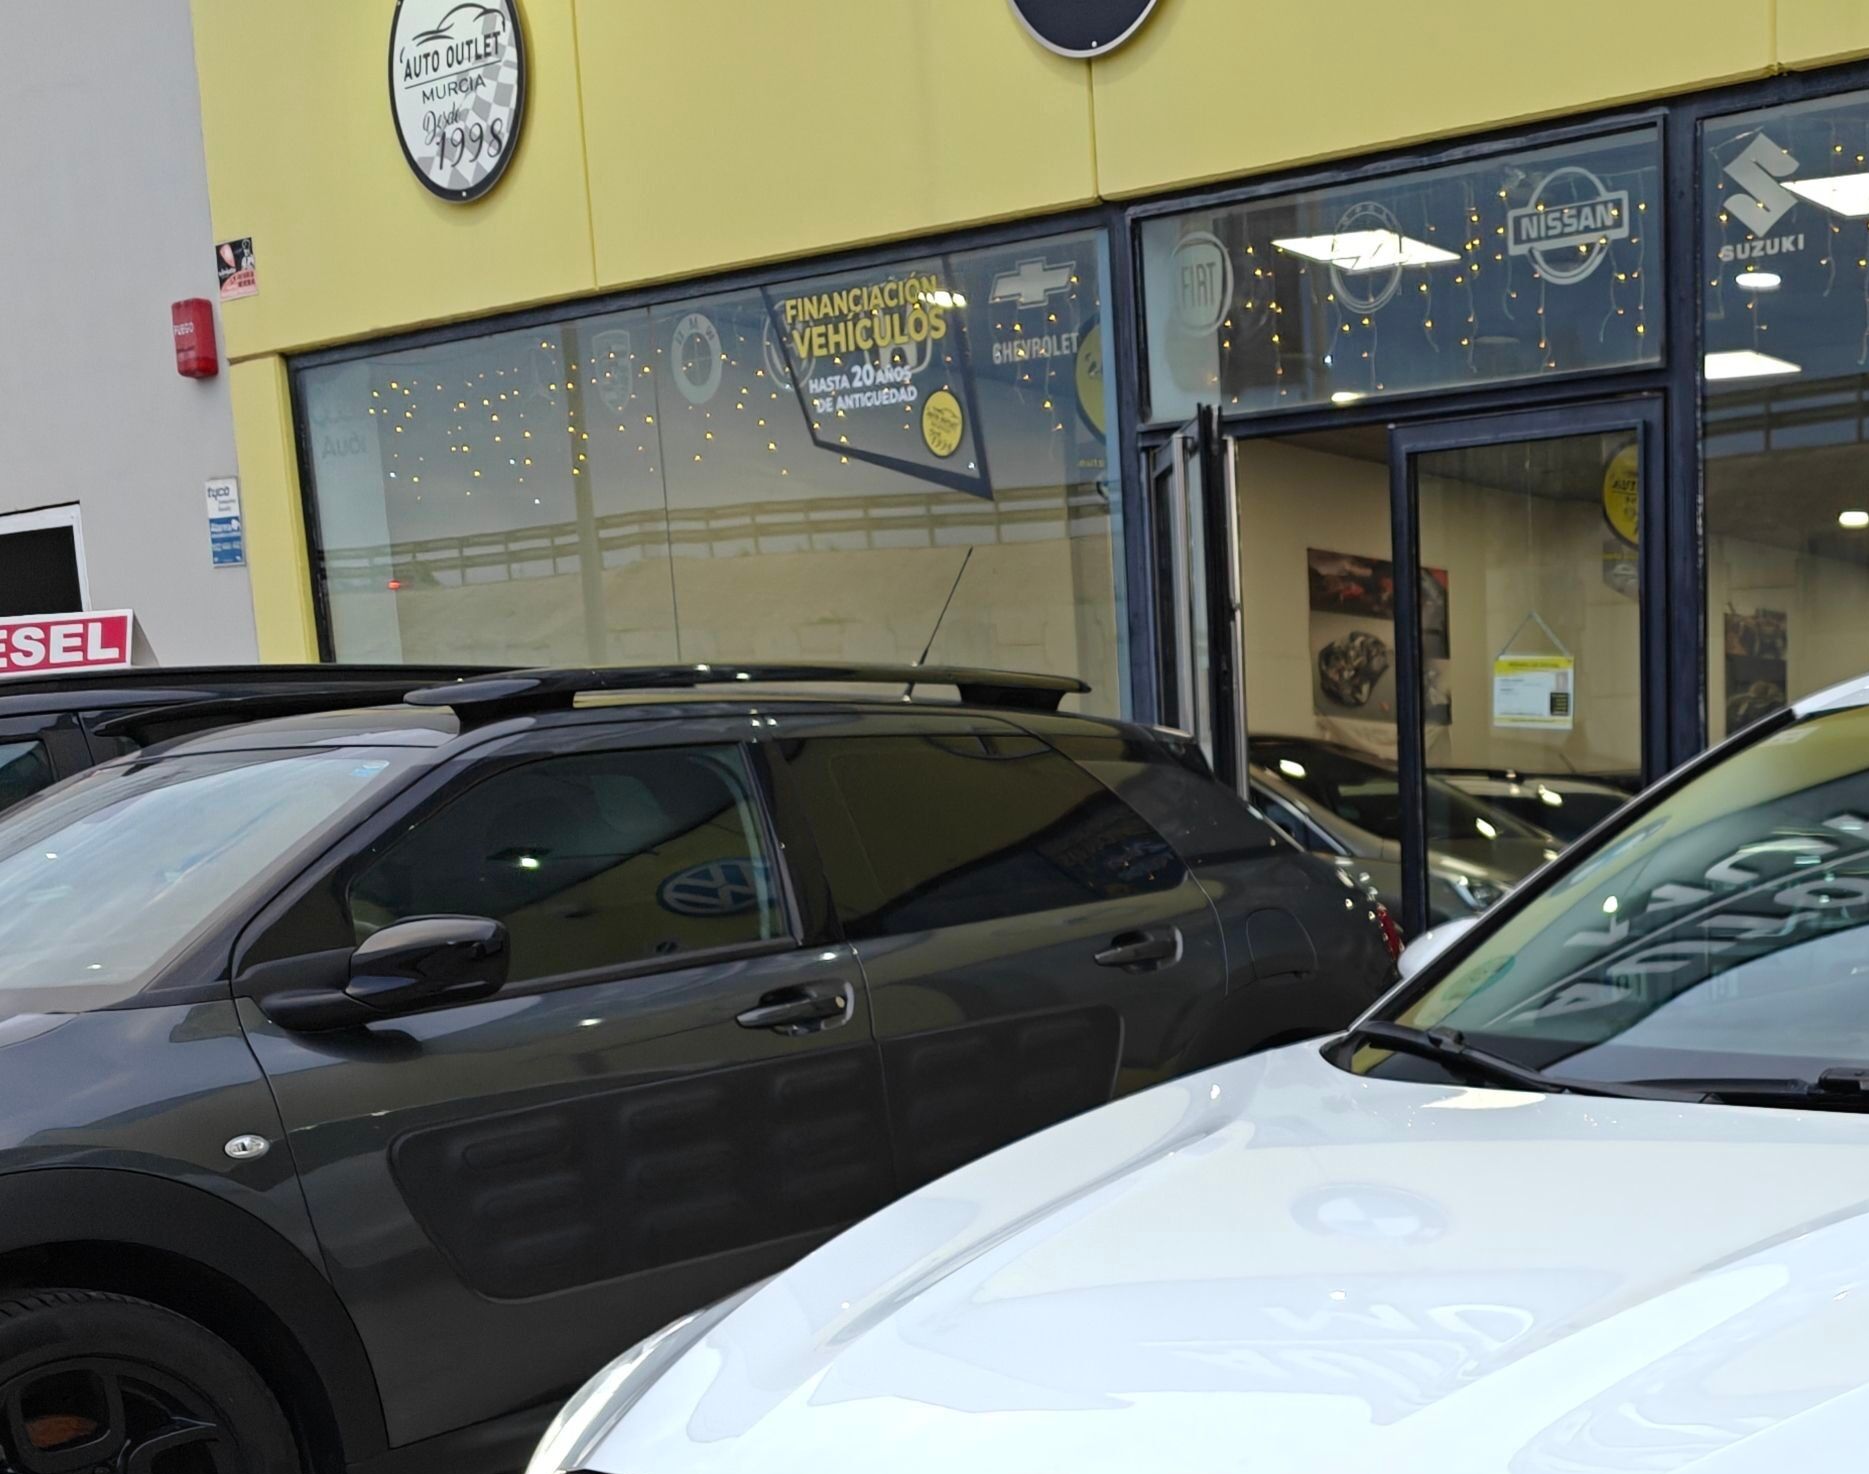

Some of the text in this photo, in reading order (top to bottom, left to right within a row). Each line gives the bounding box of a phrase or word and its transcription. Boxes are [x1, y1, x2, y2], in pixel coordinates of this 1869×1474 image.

[403, 31, 501, 82] AUTO OUTLET
[422, 74, 487, 105] MURCIA
[436, 117, 503, 171] 1998
[1520, 202, 1615, 240] NISSAN
[1720, 233, 1805, 262] SUZUKI
[785, 271, 937, 323] FINANCIACIÓN
[1181, 262, 1217, 308] FIAT
[792, 308, 946, 359] VEHÍCULOS
[992, 332, 1080, 365] CHEVROLET
[808, 375, 849, 394] HASTA
[851, 364, 874, 387] 20
[816, 385, 918, 413] DE ANTIGUEDAD
[0, 622, 119, 668] SEL
